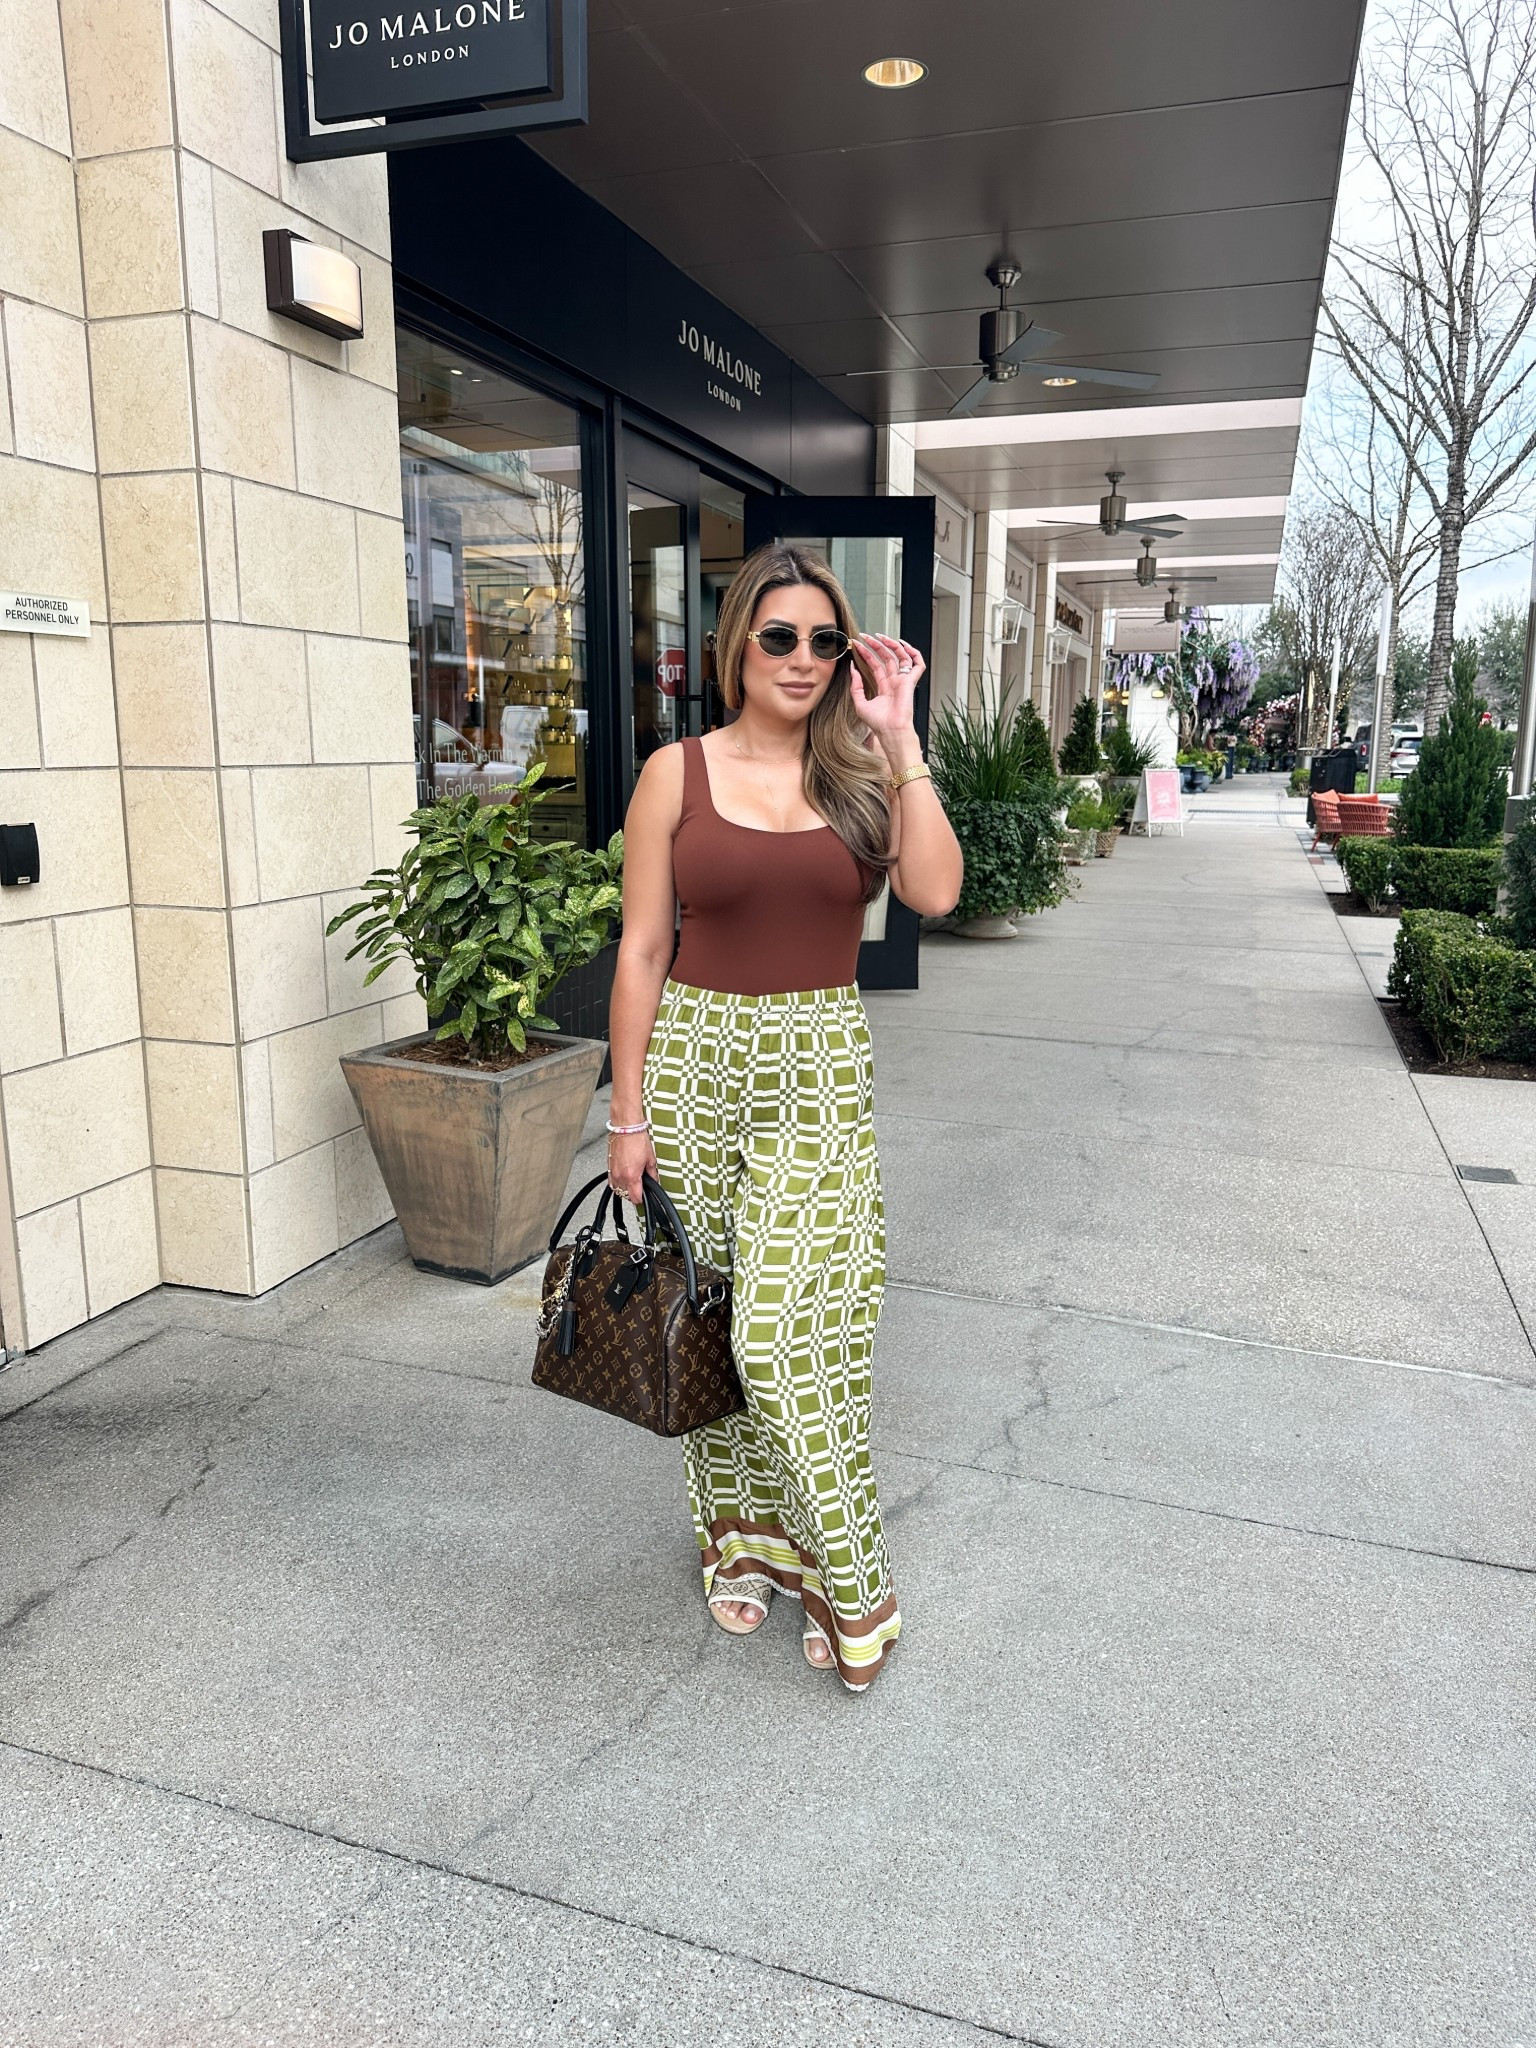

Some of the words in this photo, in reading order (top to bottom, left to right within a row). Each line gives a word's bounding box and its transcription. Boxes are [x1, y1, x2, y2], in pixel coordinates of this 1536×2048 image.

[329, 21, 369, 49] JO
[380, 0, 526, 41] MALONE
[391, 45, 469, 69] LONDON
[678, 319, 699, 353] JO
[703, 334, 762, 396] MALONE
[707, 380, 741, 412] LONDON
[15, 596, 68, 611] AUTHORIZED
[5, 609, 57, 623] PERSONNEL
[58, 614, 79, 624] ONLY
[429, 743, 441, 764] In
[443, 742, 468, 763] The
[470, 742, 513, 762] Warmth
[417, 778, 441, 800] The
[444, 777, 486, 798] Golden
